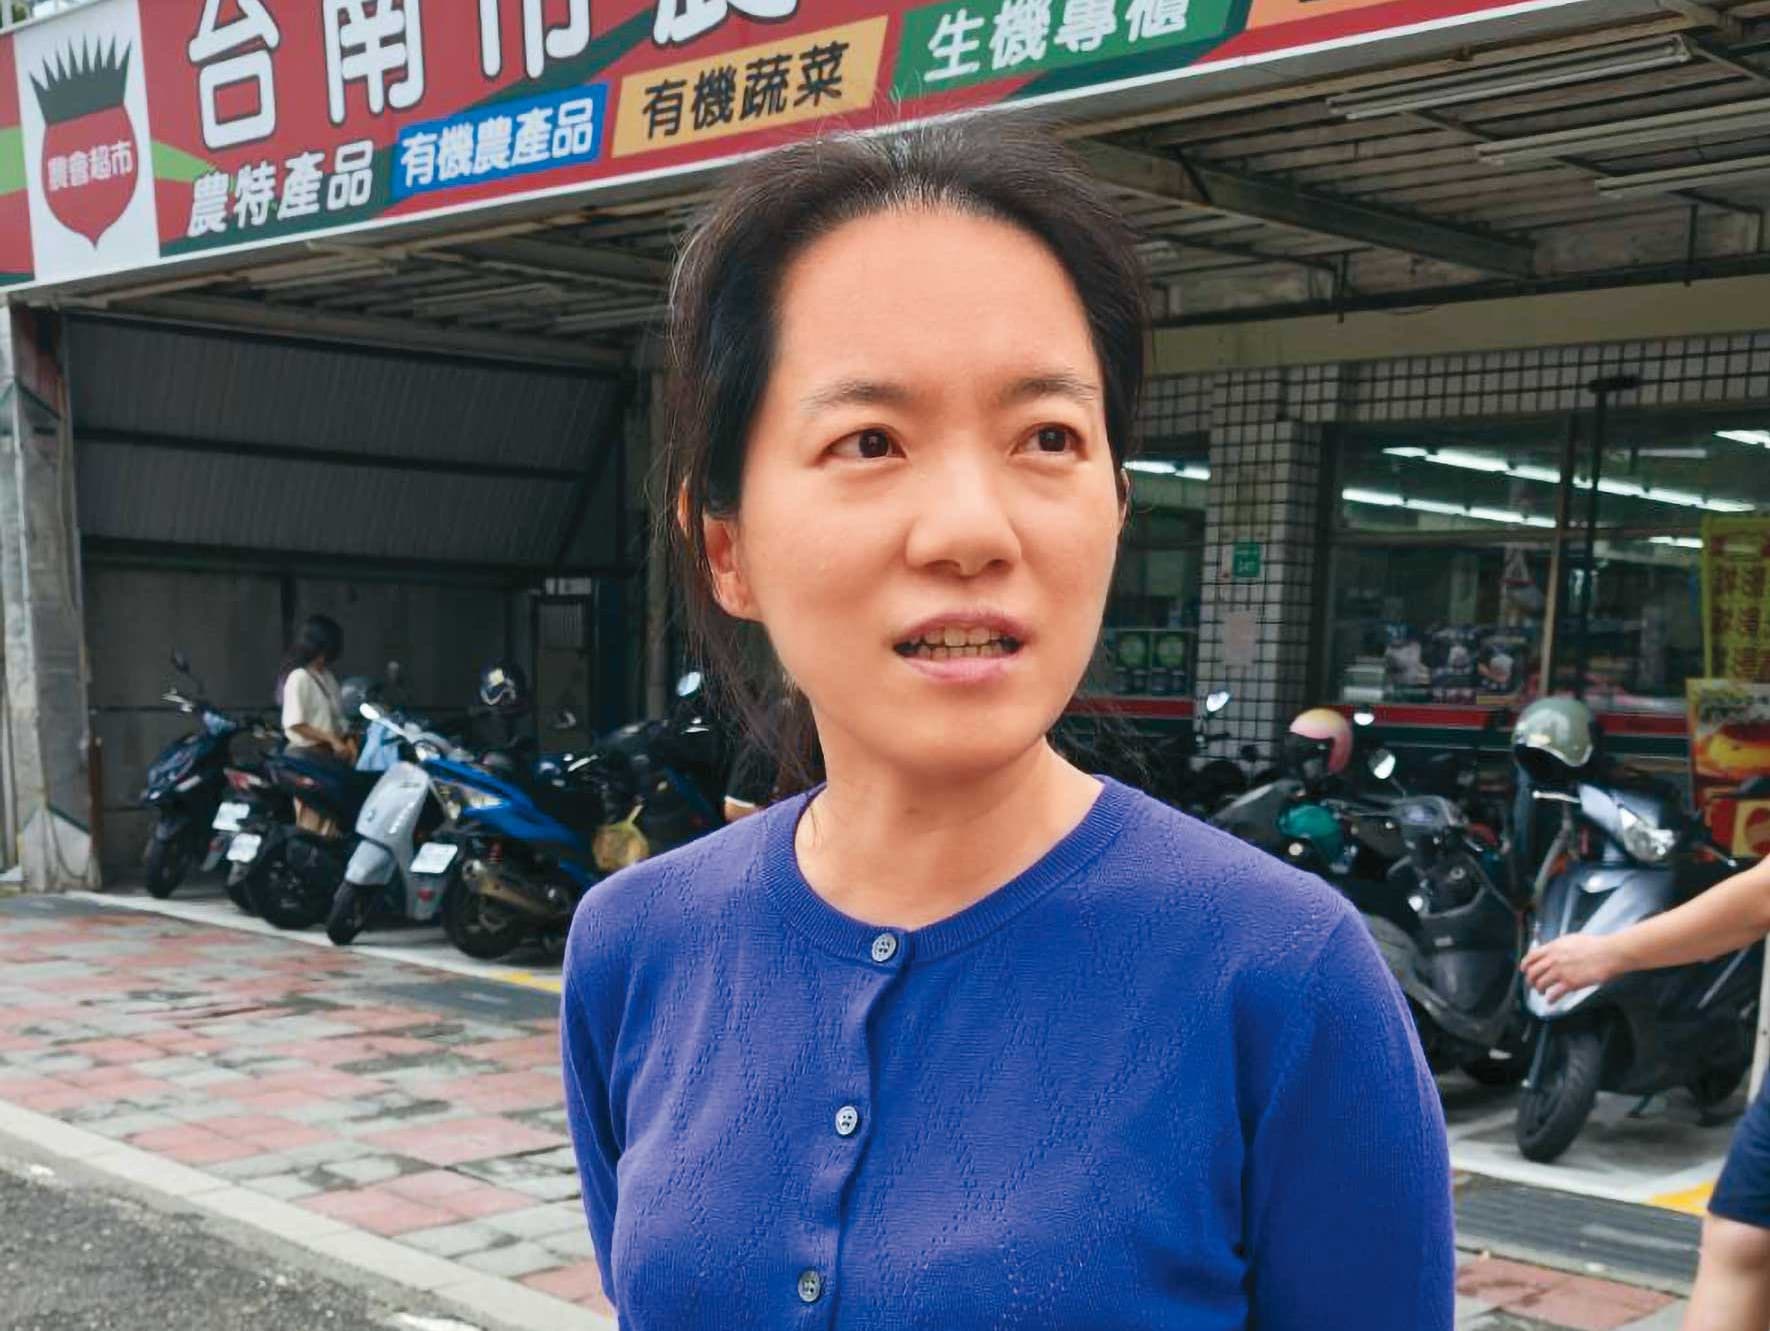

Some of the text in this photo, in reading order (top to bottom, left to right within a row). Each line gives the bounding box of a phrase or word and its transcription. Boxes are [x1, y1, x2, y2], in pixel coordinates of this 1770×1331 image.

[642, 40, 850, 140] 有機蔬菜
[47, 139, 133, 191] 農會超市
[187, 139, 374, 237] 農特產品
[400, 97, 594, 188] 有機農產品
